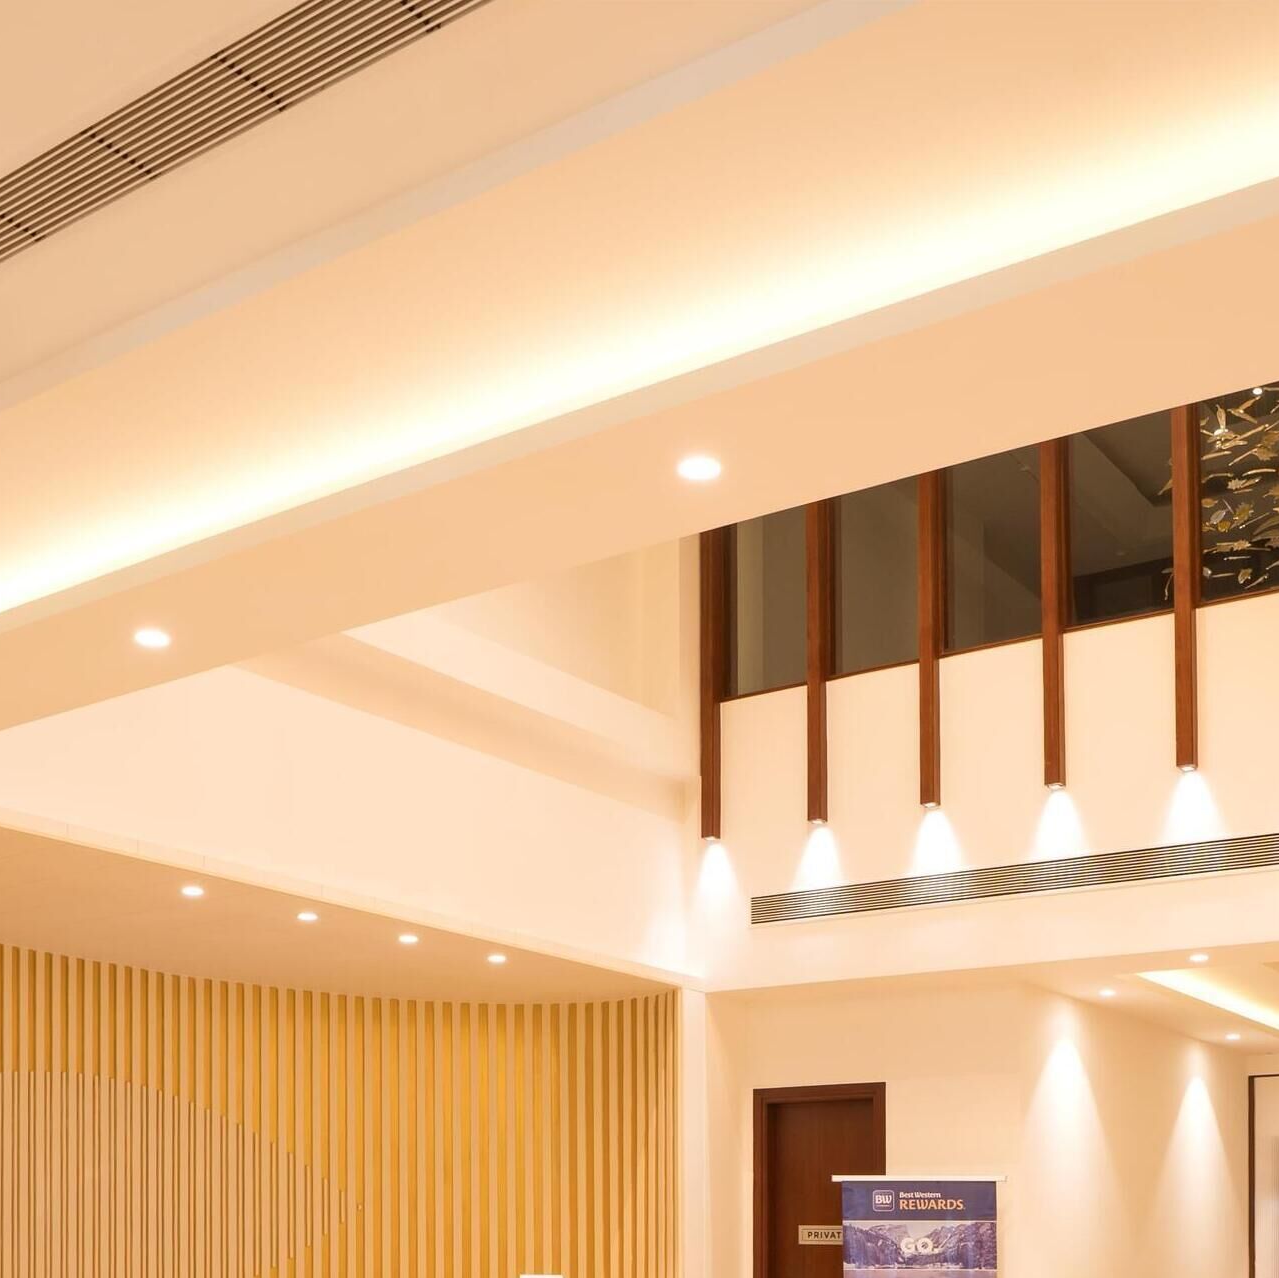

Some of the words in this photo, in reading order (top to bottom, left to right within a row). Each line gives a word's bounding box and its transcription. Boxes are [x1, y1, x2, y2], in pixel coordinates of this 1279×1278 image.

[875, 1195, 892, 1204] BW
[899, 1199, 964, 1210] REWARDS
[901, 1237, 939, 1255] GO.
